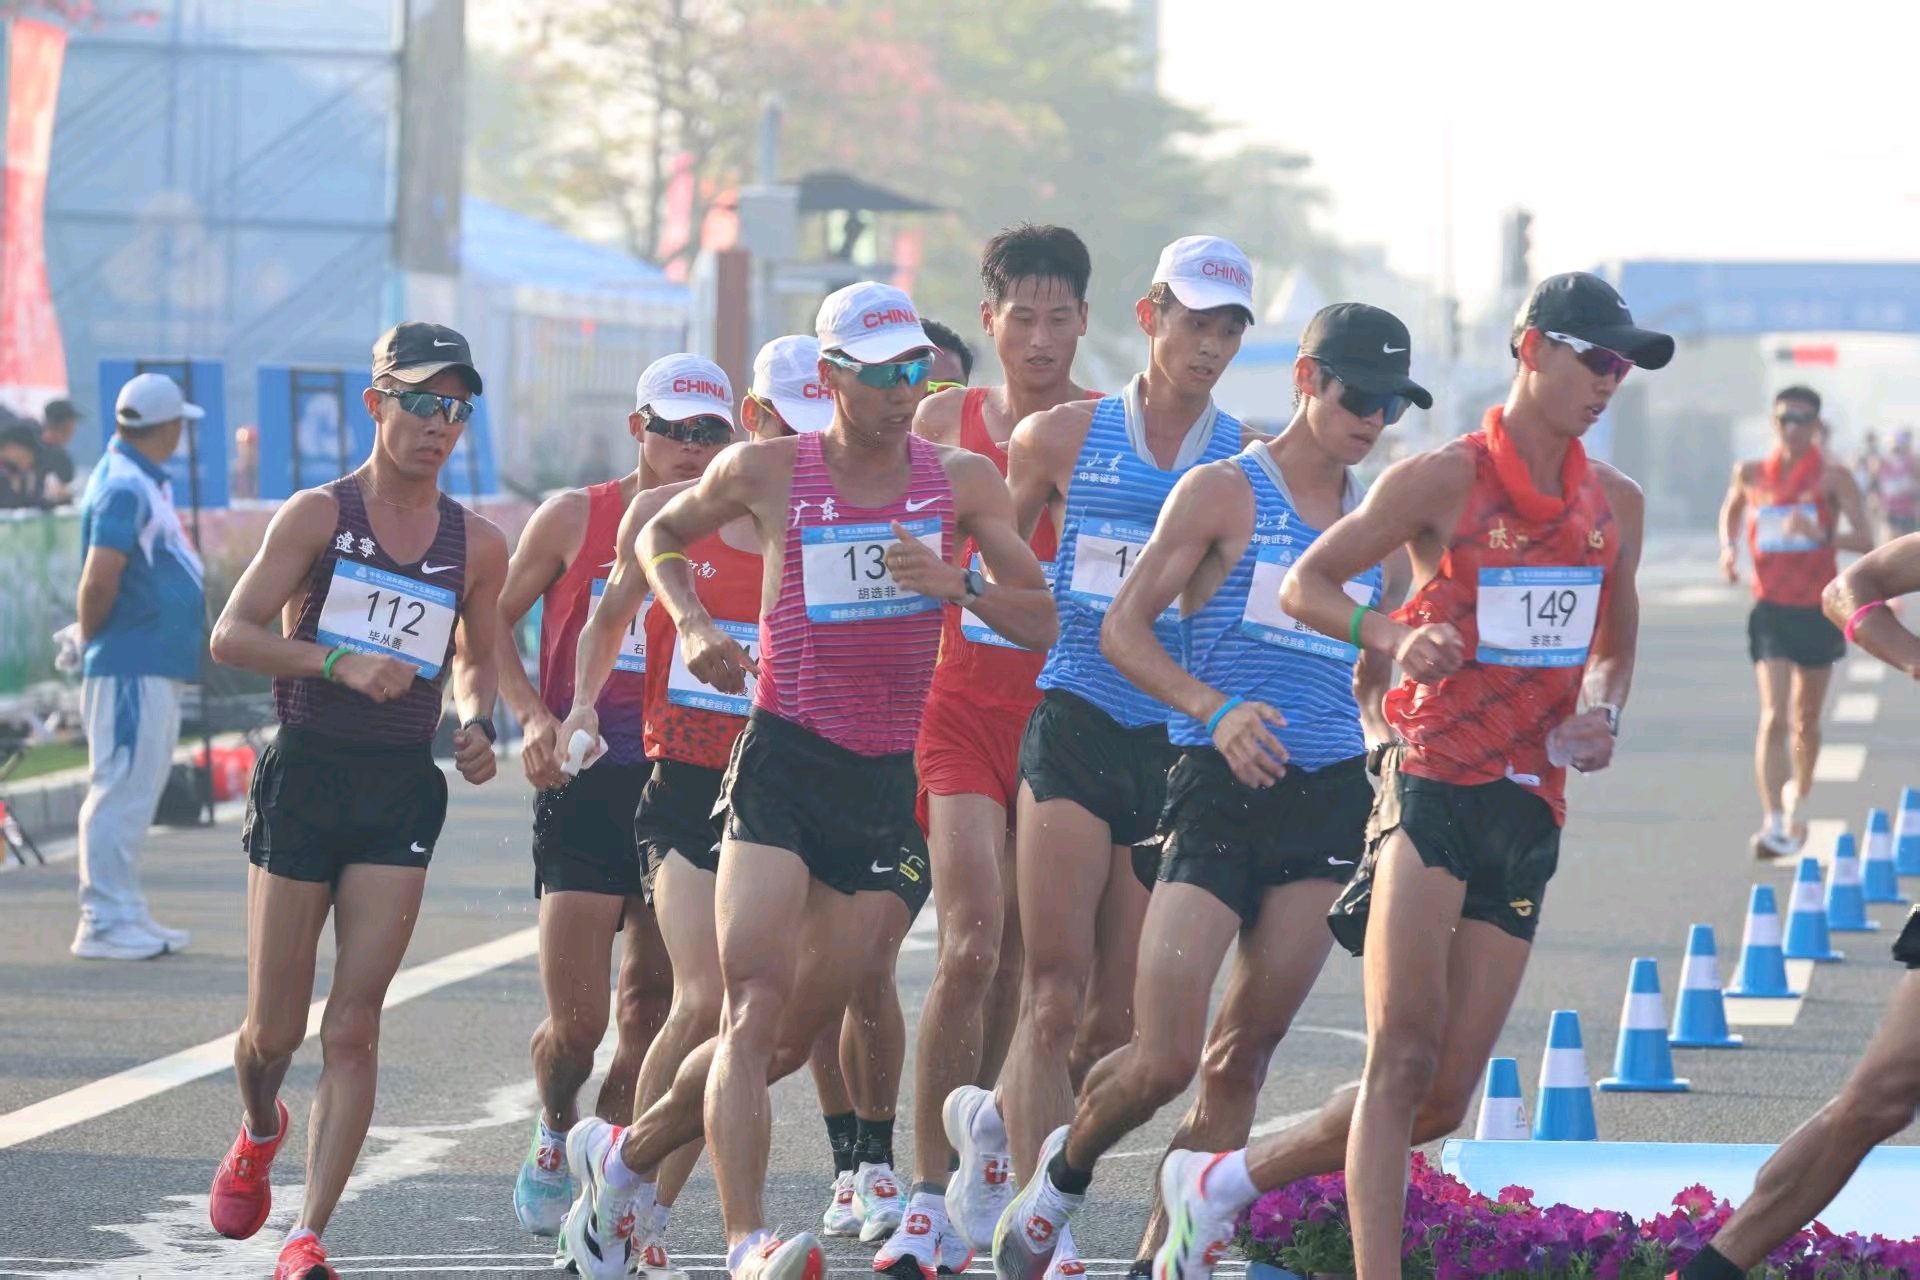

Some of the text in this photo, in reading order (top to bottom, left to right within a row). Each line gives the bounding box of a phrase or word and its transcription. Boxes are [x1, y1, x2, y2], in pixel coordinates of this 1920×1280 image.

[1202, 263, 1246, 287] CHINA
[863, 309, 918, 328] CHINA
[673, 379, 726, 400] CHINA
[803, 383, 834, 399] CH
[1080, 472, 1120, 484] 中泰证券
[1251, 533, 1292, 545] 中泰证券
[367, 590, 426, 637] 112
[1520, 589, 1577, 627] 149
[368, 629, 402, 650] 毕从善
[633, 643, 645, 655] 石
